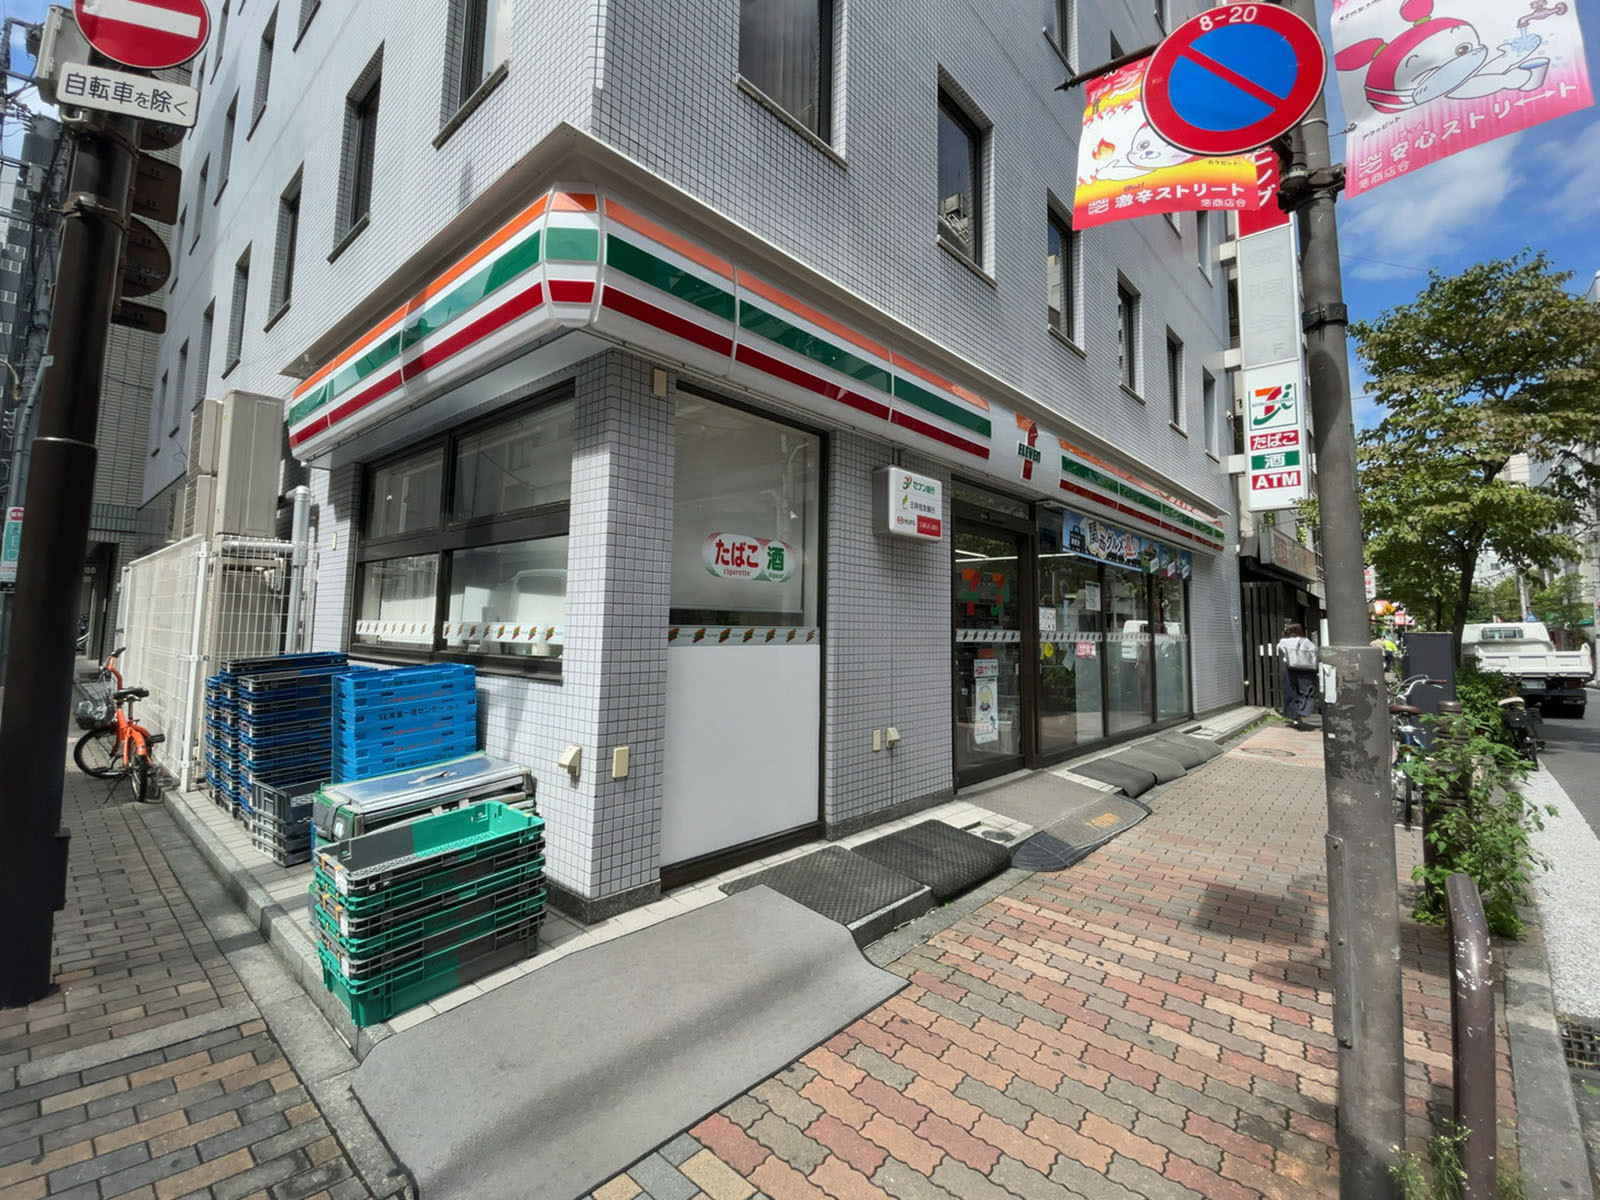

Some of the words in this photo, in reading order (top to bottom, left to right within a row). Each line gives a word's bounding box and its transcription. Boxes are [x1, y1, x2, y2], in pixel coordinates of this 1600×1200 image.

[1198, 6, 1258, 31] 8-20
[65, 72, 189, 117] 自転車を除く
[1115, 183, 1245, 209] 激辛ストリート
[1252, 433, 1297, 449] たばこ
[1264, 453, 1286, 469] 酒
[1256, 473, 1298, 489] ATM
[715, 539, 759, 568] たばこ
[767, 545, 784, 571] 酒
[723, 568, 751, 577] cigarette
